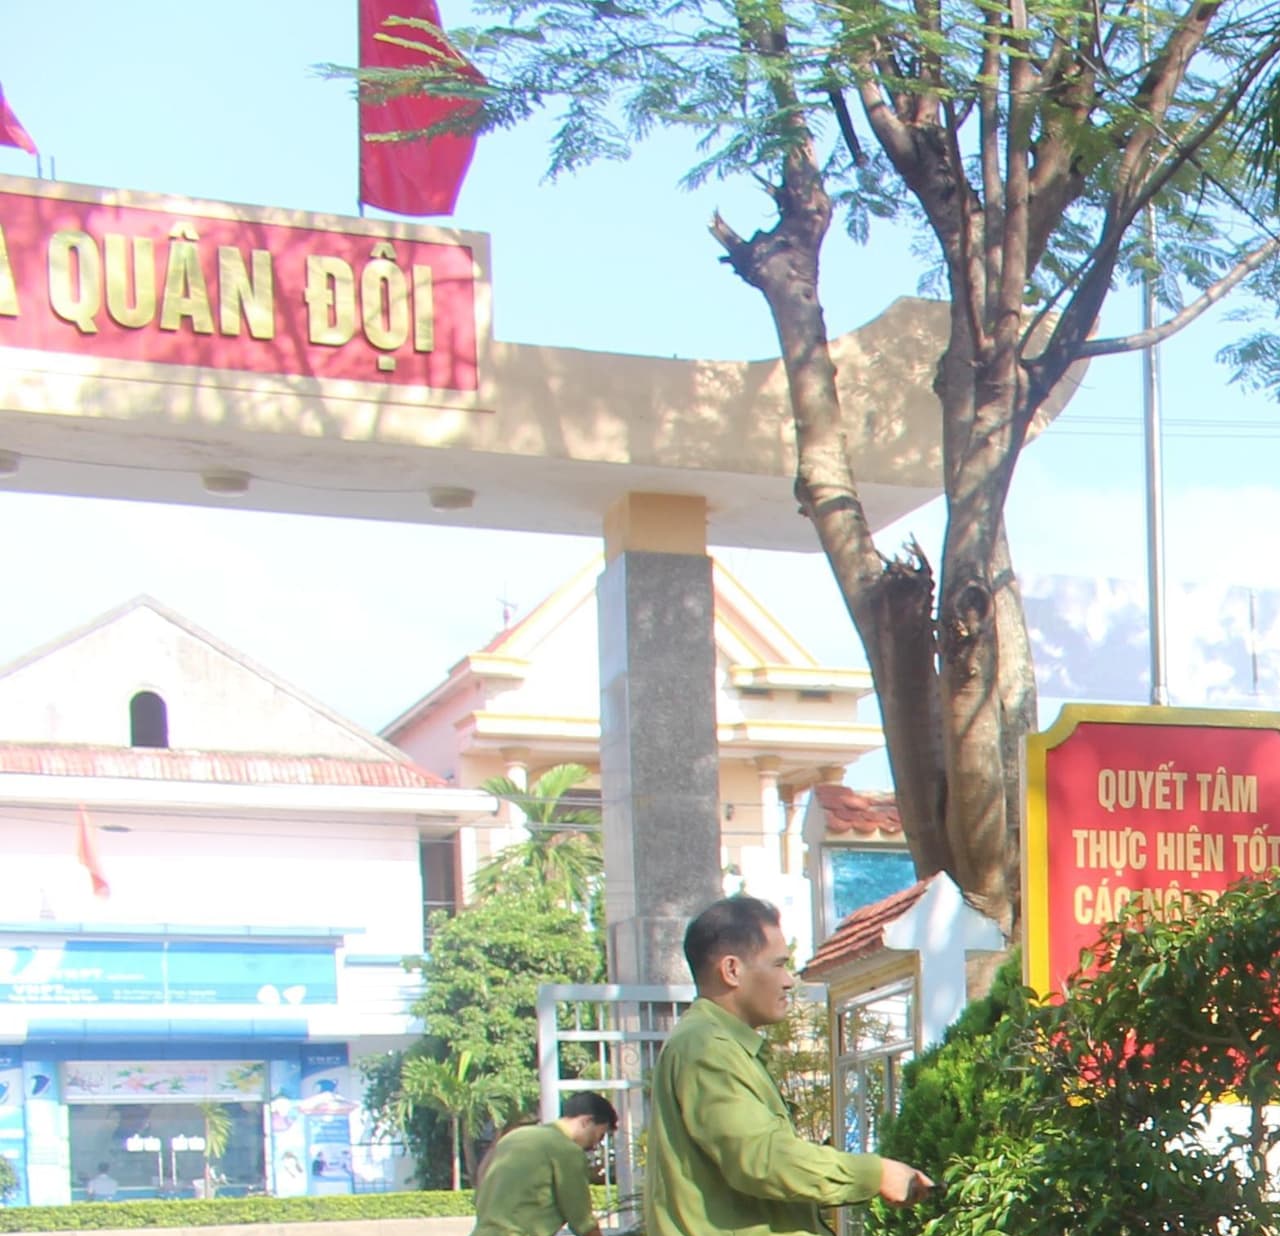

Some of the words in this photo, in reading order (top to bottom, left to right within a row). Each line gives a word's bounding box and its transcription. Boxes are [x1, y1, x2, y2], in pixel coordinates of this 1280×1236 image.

[47, 221, 276, 340] QUÂN
[305, 242, 436, 373] ĐỘI
[1098, 761, 1188, 812] QUYẾT
[1196, 766, 1258, 813] TÂM
[1072, 827, 1147, 877] THỰC
[1157, 825, 1224, 879] HIỆN
